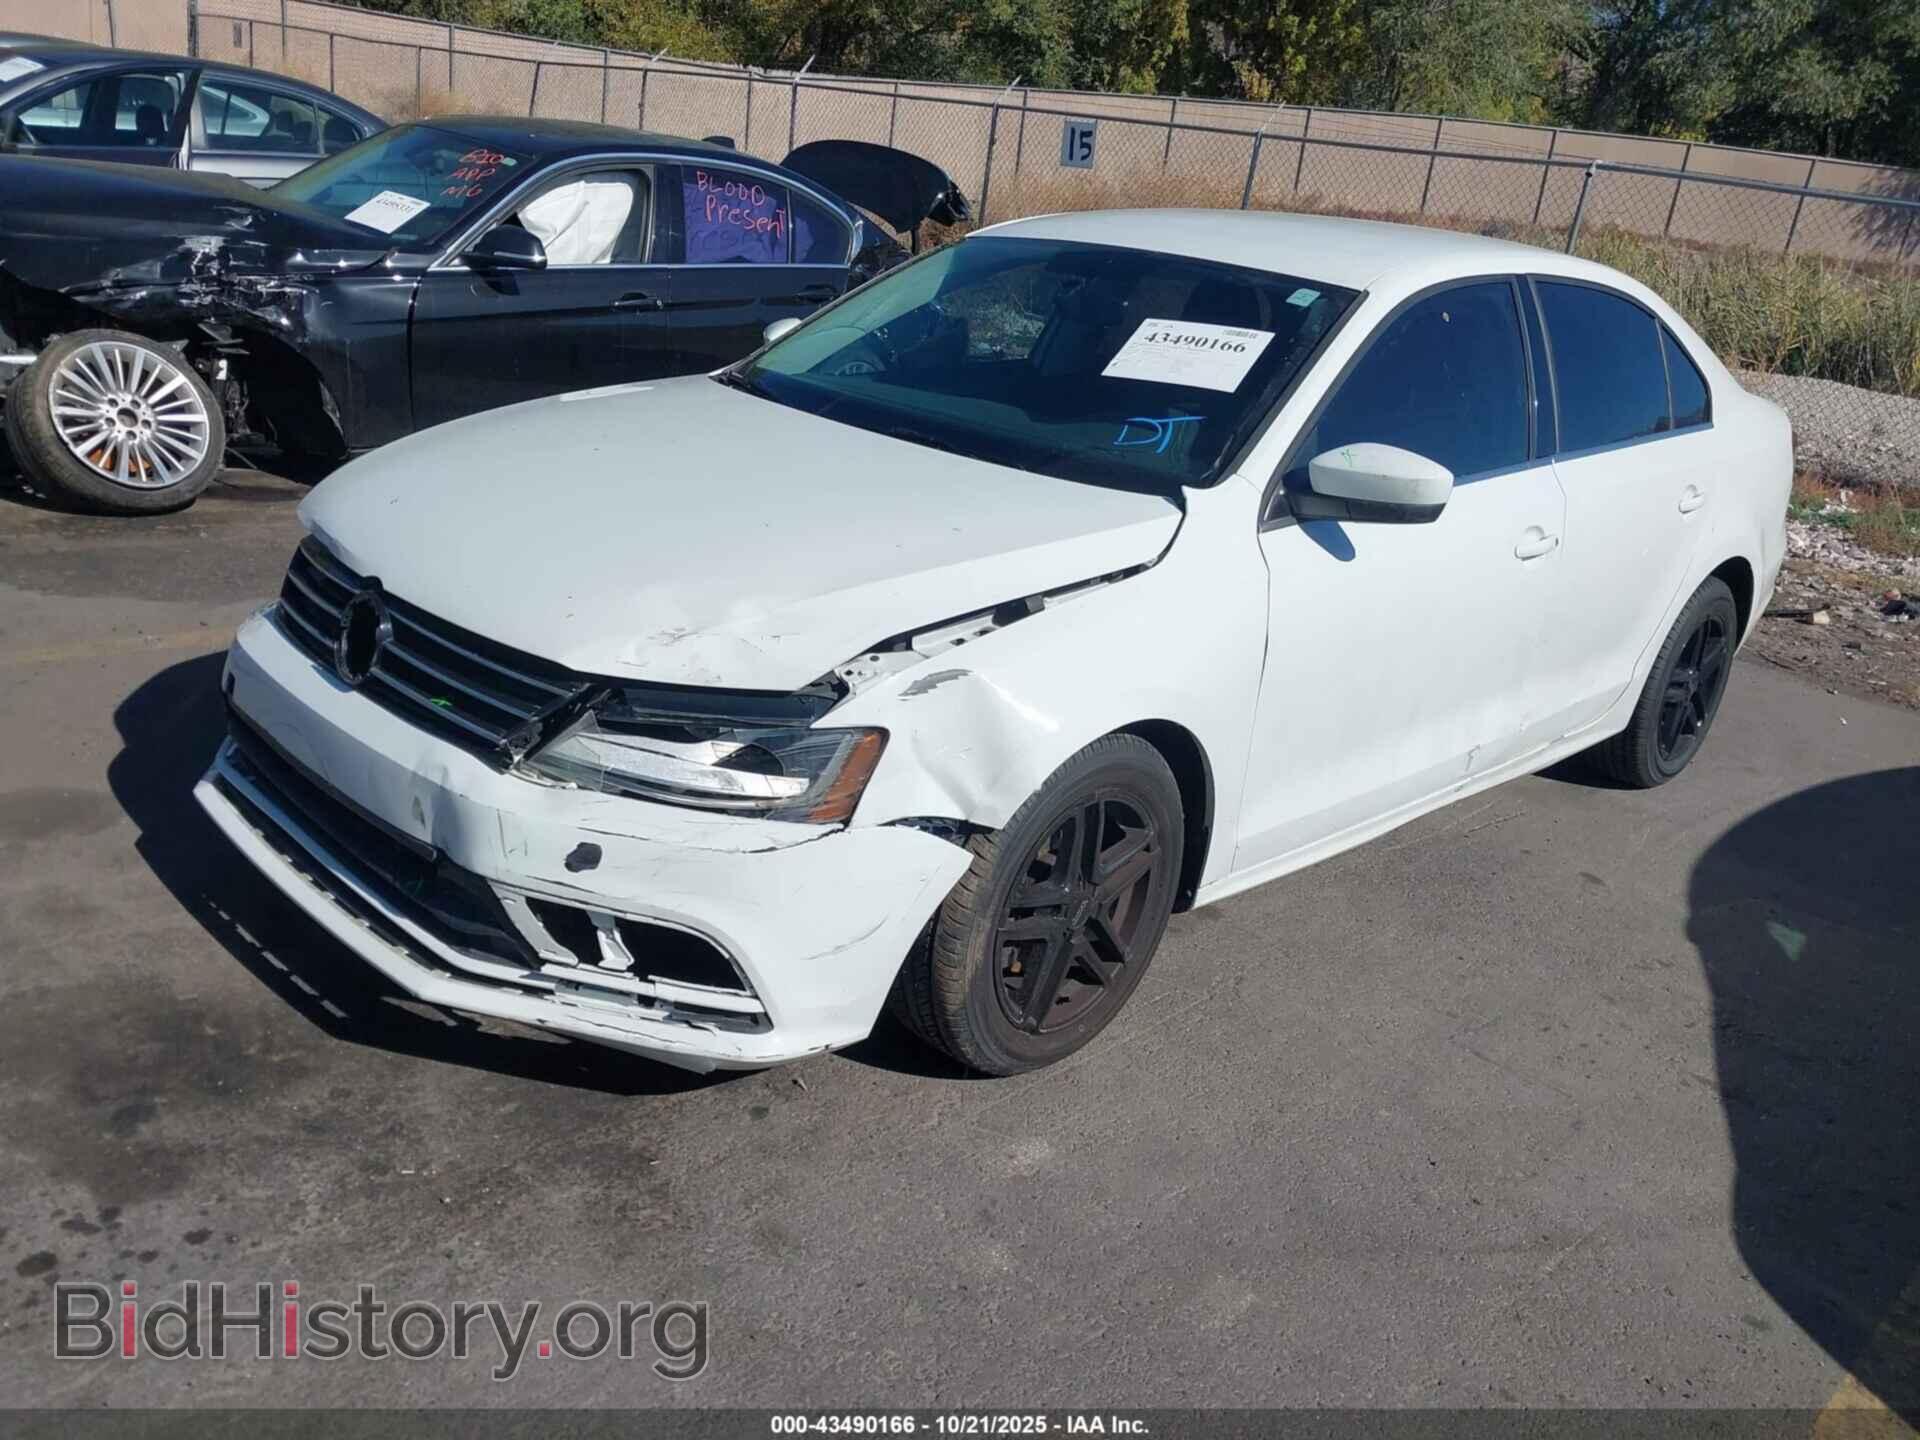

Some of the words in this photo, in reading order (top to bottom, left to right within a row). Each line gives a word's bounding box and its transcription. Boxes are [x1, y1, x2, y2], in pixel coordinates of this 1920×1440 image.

[1069, 127, 1093, 161] 15
[1144, 331, 1247, 353] 43490166
[1113, 416, 1208, 454] DT
